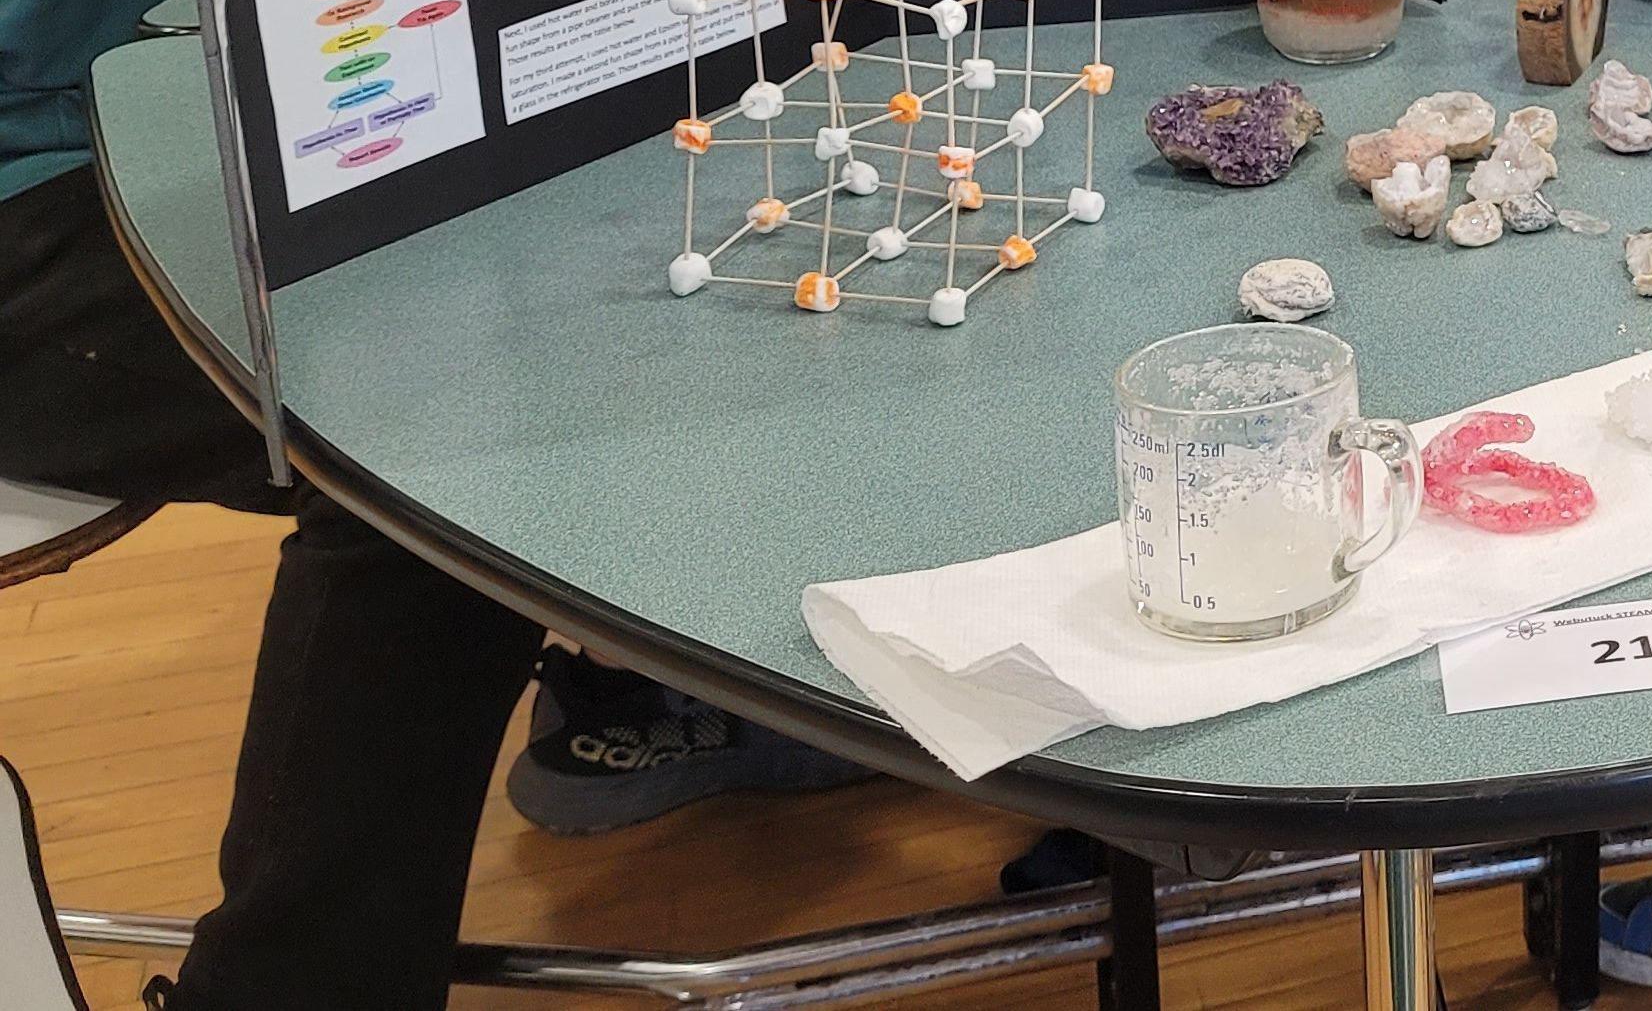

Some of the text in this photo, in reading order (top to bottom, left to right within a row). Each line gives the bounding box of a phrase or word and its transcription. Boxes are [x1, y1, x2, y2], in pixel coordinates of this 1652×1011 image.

[1133, 462, 1154, 483] 200
[1188, 473, 1196, 487] 2
[1135, 503, 1152, 523] 150
[1190, 512, 1209, 528] 1.5
[1137, 538, 1154, 558] 100
[1190, 552, 1196, 567] 1
[1139, 582, 1151, 597] 50
[1553, 613, 1613, 627] Webutuck
